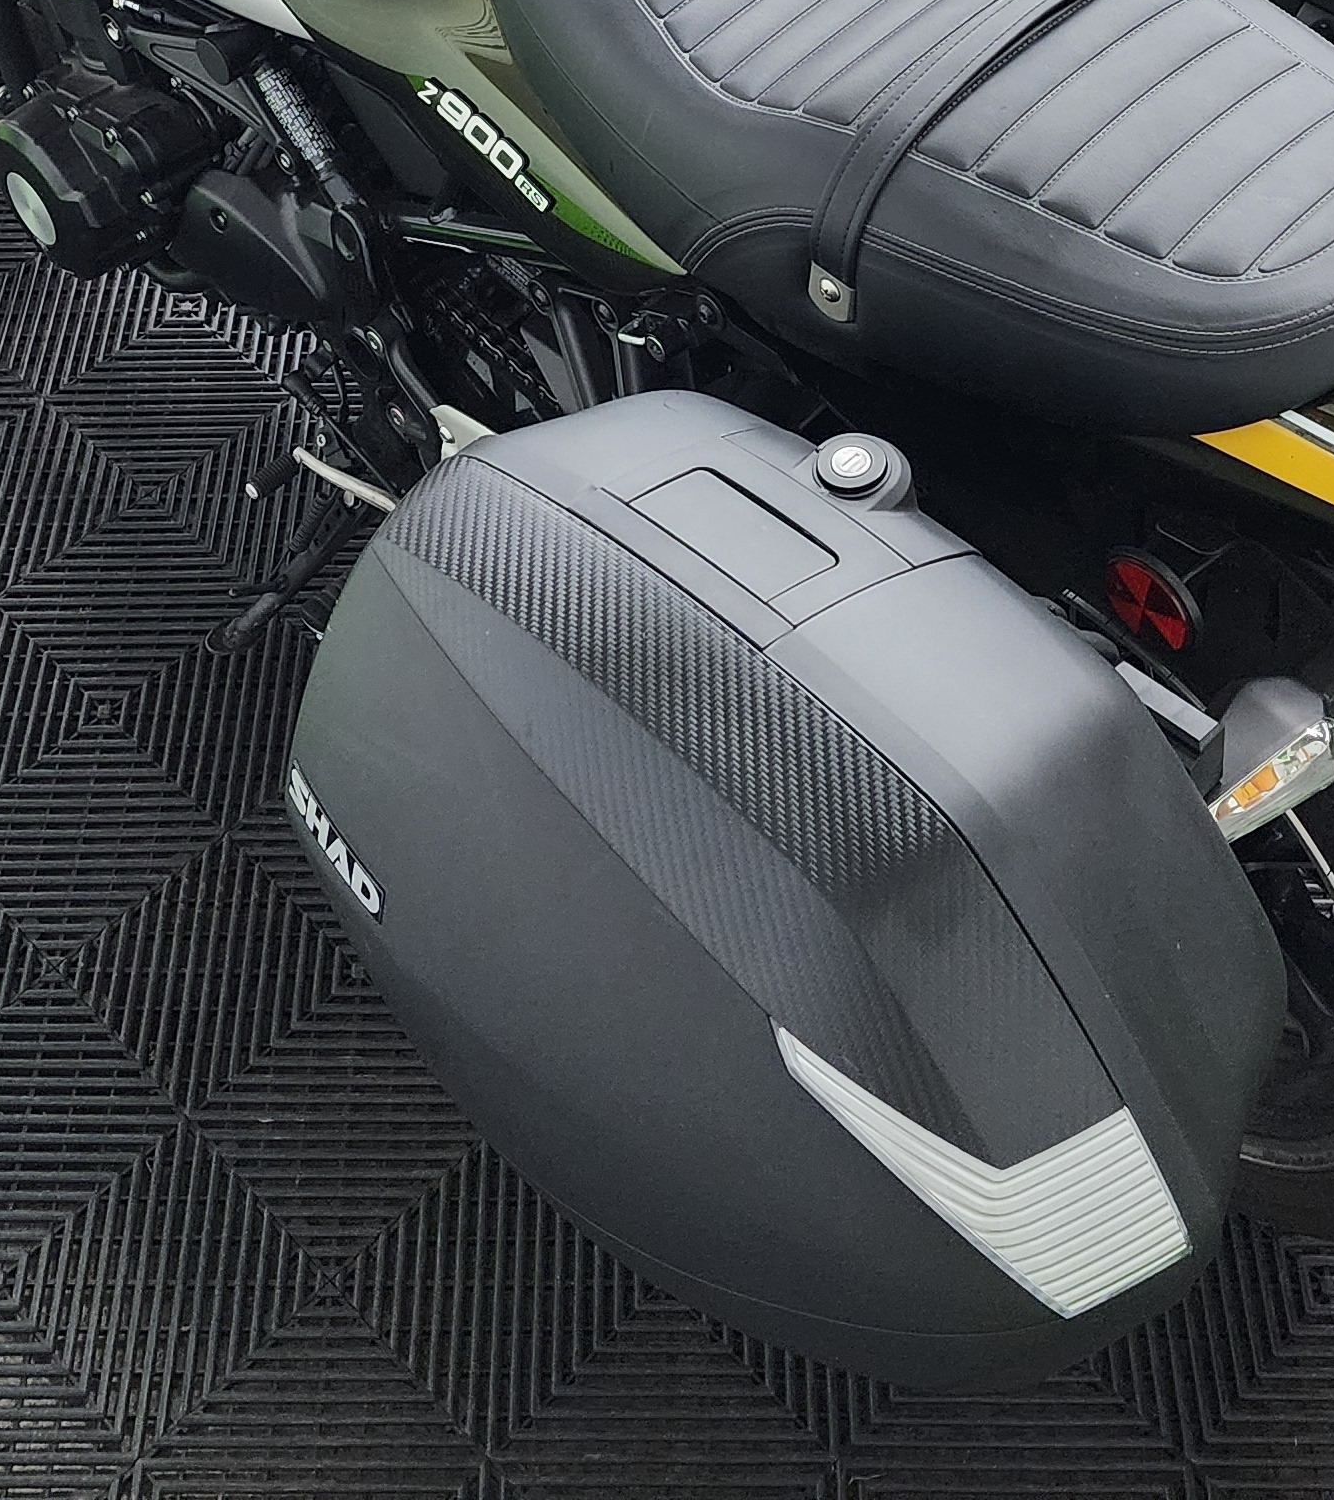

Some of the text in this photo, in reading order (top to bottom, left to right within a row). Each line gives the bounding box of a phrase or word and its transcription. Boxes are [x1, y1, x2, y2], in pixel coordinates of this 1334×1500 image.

[416, 80, 524, 181] Z900
[519, 180, 544, 207] RS
[288, 768, 380, 914] SHAD
